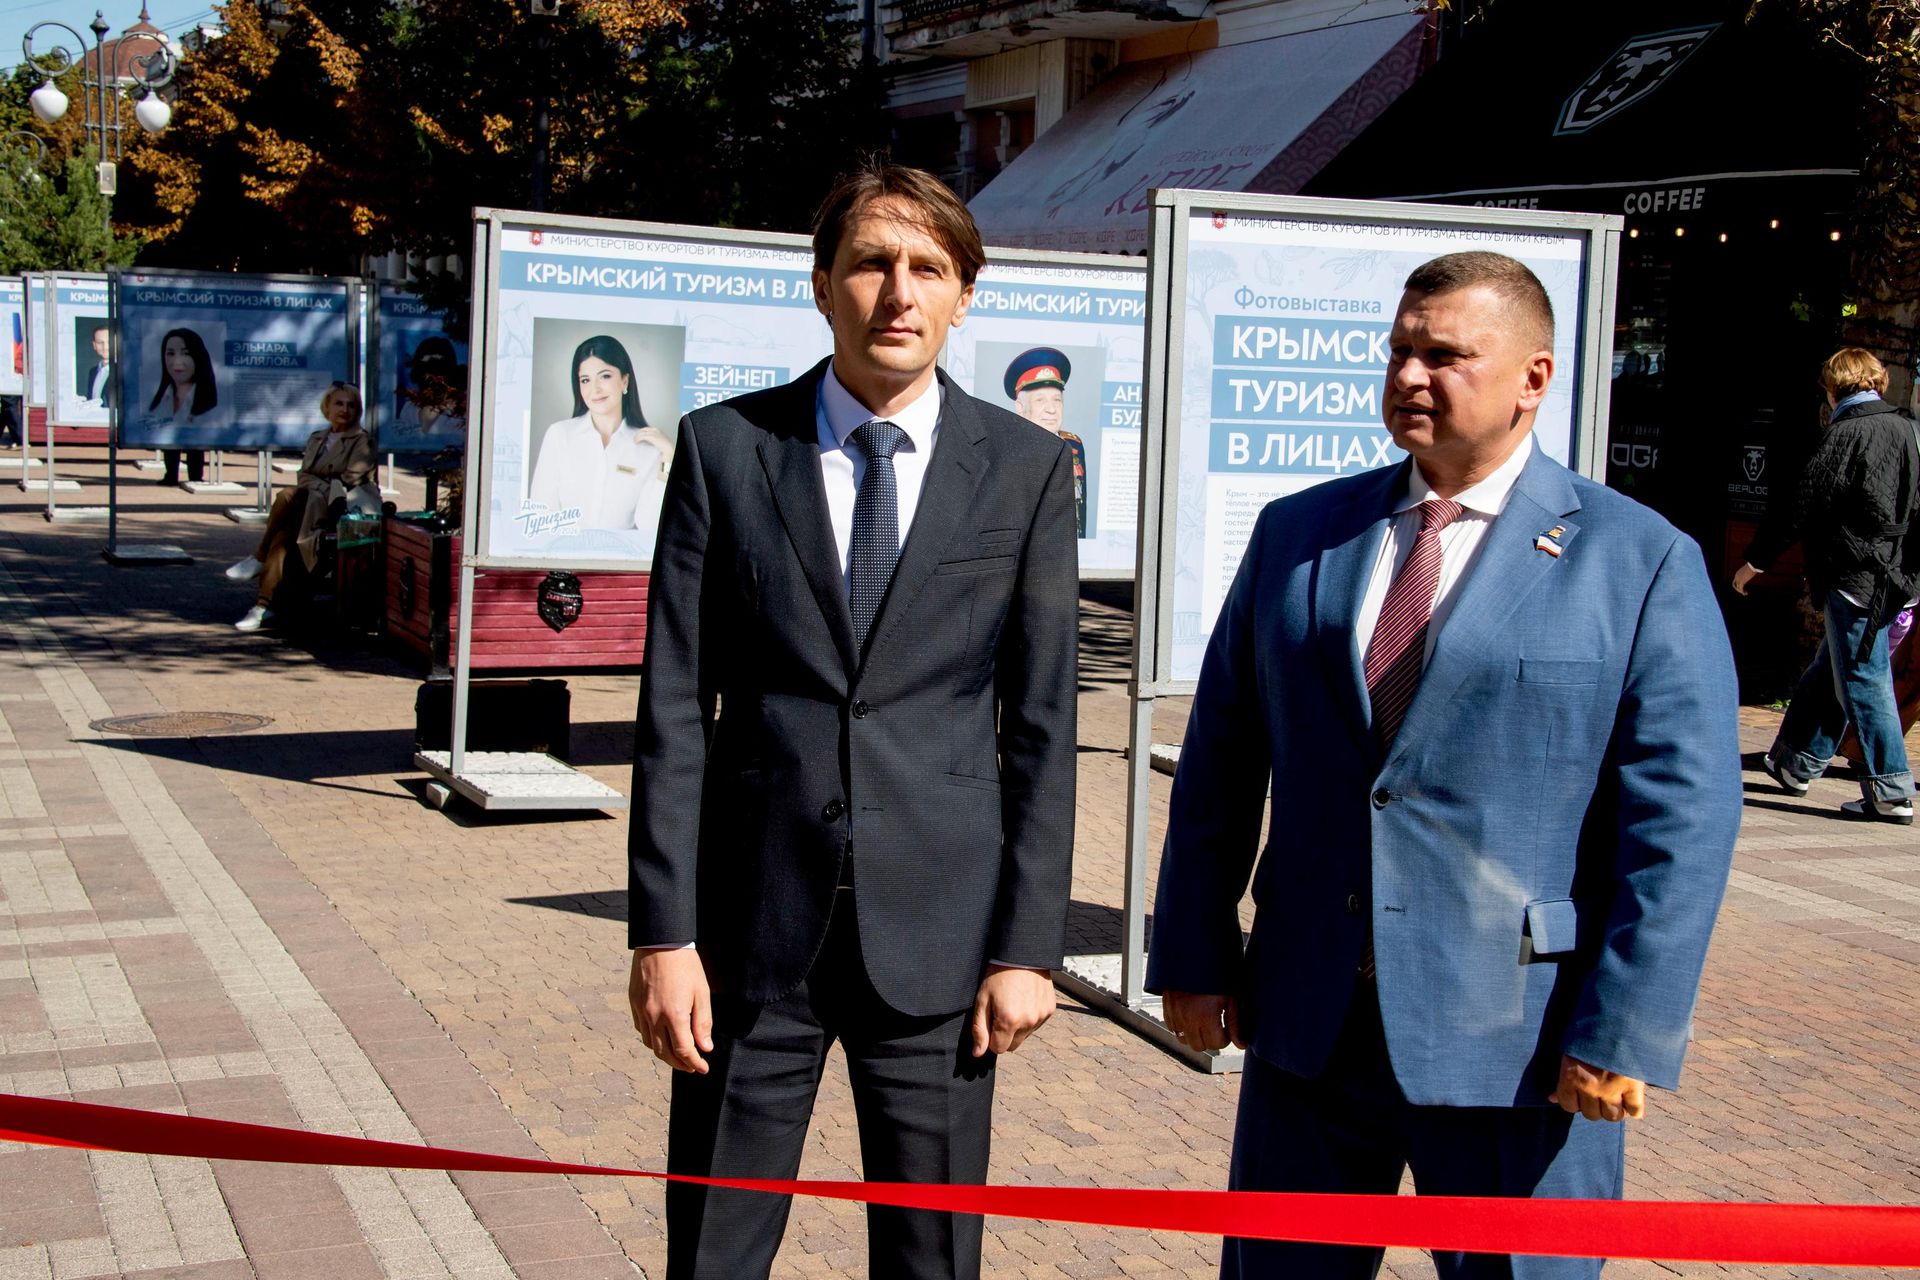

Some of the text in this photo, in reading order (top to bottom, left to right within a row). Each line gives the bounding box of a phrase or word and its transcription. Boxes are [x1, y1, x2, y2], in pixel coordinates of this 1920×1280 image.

[1623, 187, 1705, 215] COFFEE
[1234, 216, 1565, 245] МИНИСТЕРСТВО КУРОРТОВ И ТУРИЗМА РЕСПУБЛИКИ КРЫМ
[551, 234, 644, 252] МИНИСТЕРСТВО
[647, 240, 705, 256] КУРОРТОВ
[707, 246, 717, 256] И
[719, 247, 769, 261] ТУРИЗМА
[527, 262, 666, 292] КРЫМСКИЙ
[672, 272, 766, 299] ТУРИЗМ
[772, 279, 786, 299] В
[992, 264, 1072, 279] МИНИСТЕРСТВО
[1075, 268, 1124, 281] КУРОРТОВ
[1126, 271, 1133, 281] И
[70, 291, 108, 303] КРЫМ
[136, 290, 333, 311] КРЫМСКИЙ ТУРИЗМ В ЛИЦАХ
[971, 289, 1090, 315] КРЫМСКИЙ
[1234, 285, 1381, 314] Фотовыставка
[232, 342, 289, 354] ЭЛЬНАРА
[1232, 325, 1391, 364] КРЫМСК
[232, 355, 299, 367] БИЛЯЛОВА
[694, 365, 776, 388] ЗЕЙНЕП
[1113, 385, 1142, 403] АН
[1229, 379, 1376, 416] ТУРИЗМ
[1227, 432, 1394, 473] В ЛИЦАХ
[522, 500, 548, 511] День
[513, 507, 581, 537] Туризма
